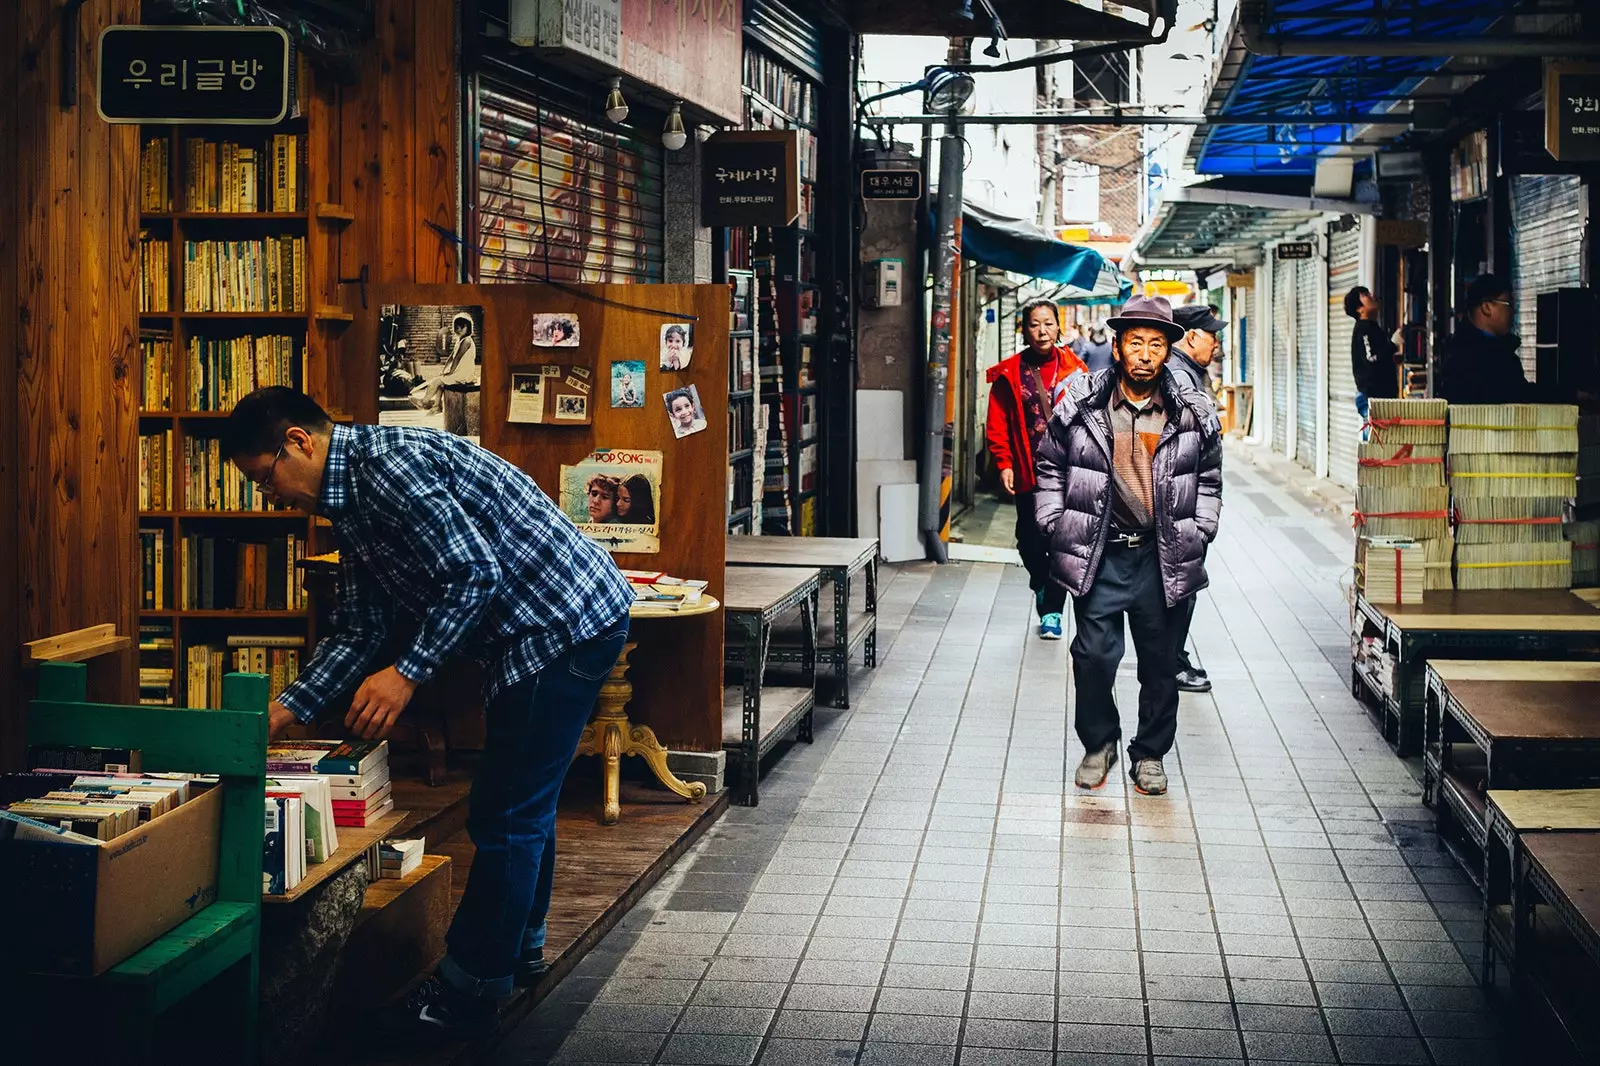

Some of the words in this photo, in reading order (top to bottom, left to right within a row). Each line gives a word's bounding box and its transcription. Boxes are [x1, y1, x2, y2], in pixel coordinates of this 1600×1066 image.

[123, 59, 263, 91] 우리글방
[1568, 97, 1599, 113] 경희
[715, 166, 777, 183] 국제서적
[595, 453, 615, 463] POP
[617, 452, 644, 465] SONG
